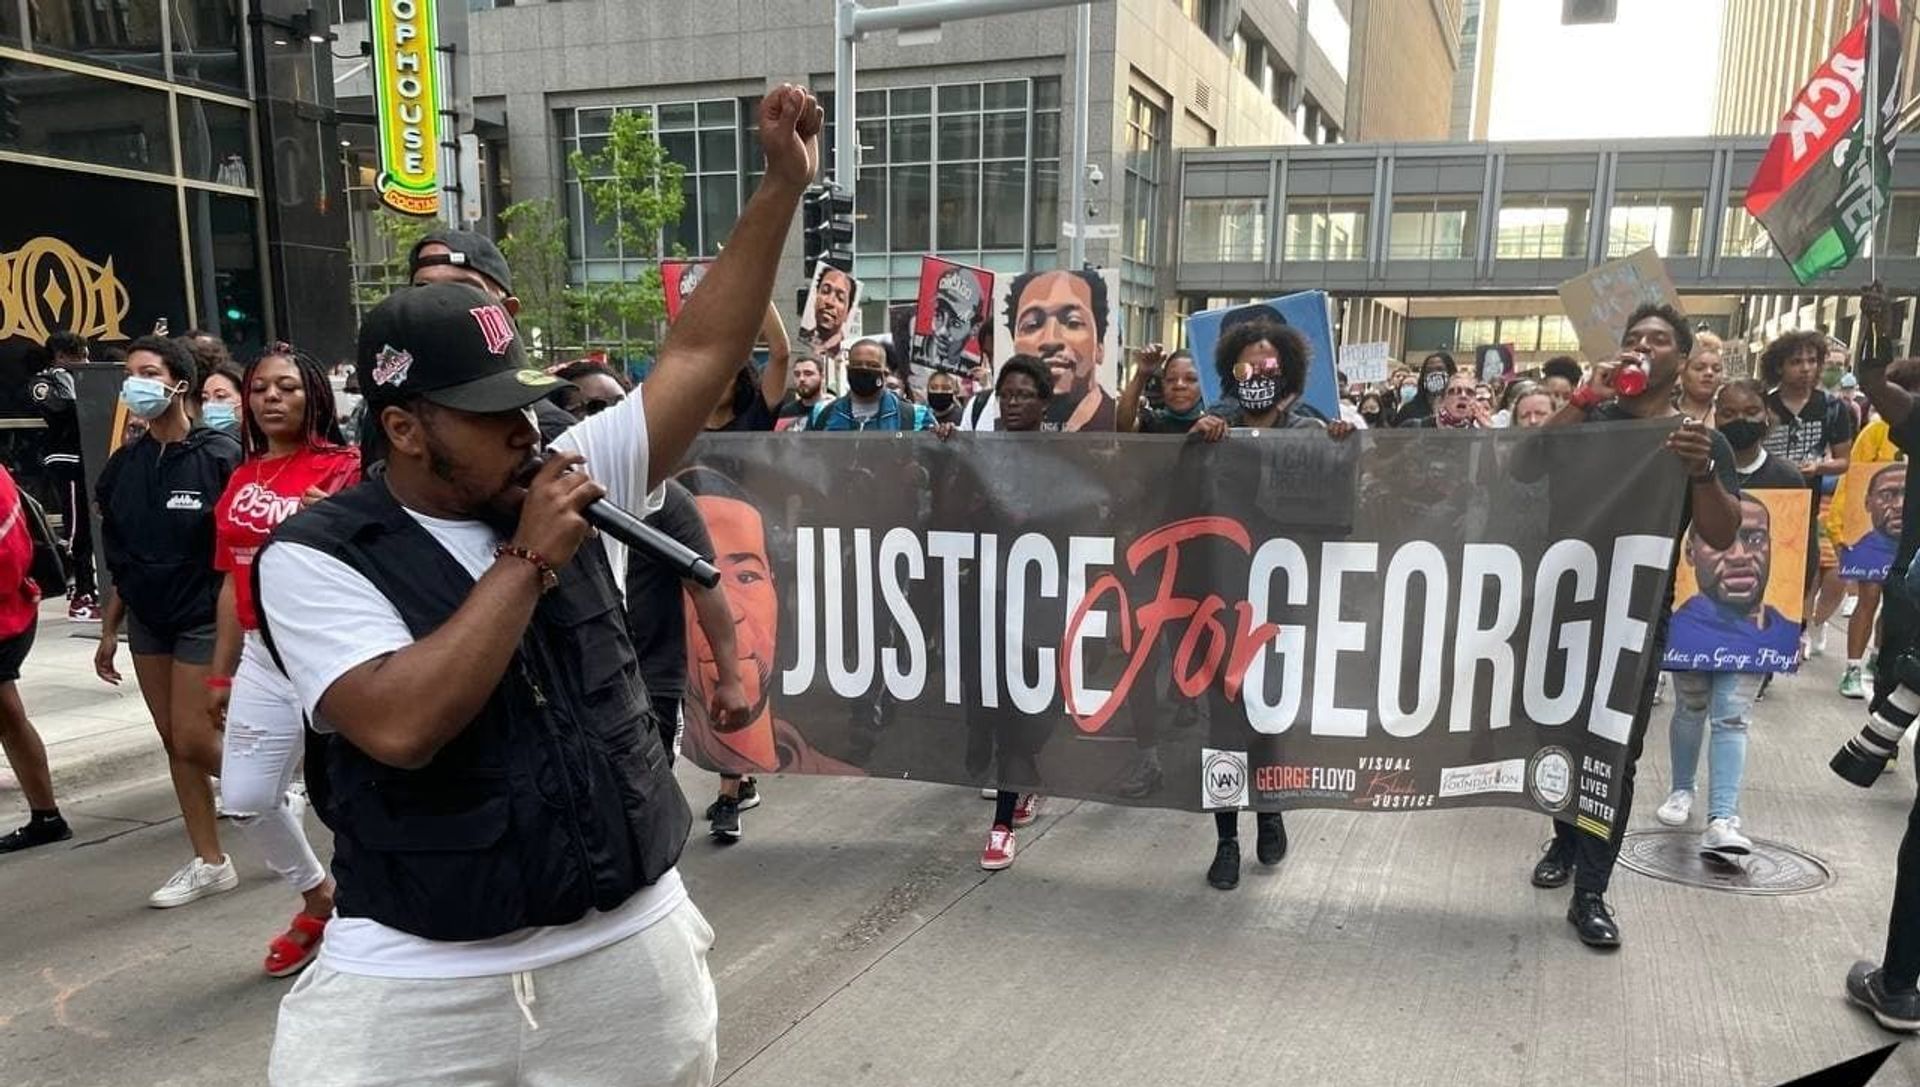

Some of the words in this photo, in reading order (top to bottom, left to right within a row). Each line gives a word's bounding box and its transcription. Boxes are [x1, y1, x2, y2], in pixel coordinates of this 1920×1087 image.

[783, 526, 1115, 716] JUSTICE
[1060, 515, 1281, 734] For
[1242, 526, 1675, 746] GEORGE
[1713, 647, 1753, 670] George
[1755, 647, 1800, 670] Floyd
[1358, 756, 1412, 770] VISUAL
[1582, 755, 1613, 779] BLACK
[1210, 772, 1239, 788] NAN
[1580, 775, 1609, 799] LIVES
[1372, 794, 1436, 808] JUSTICE
